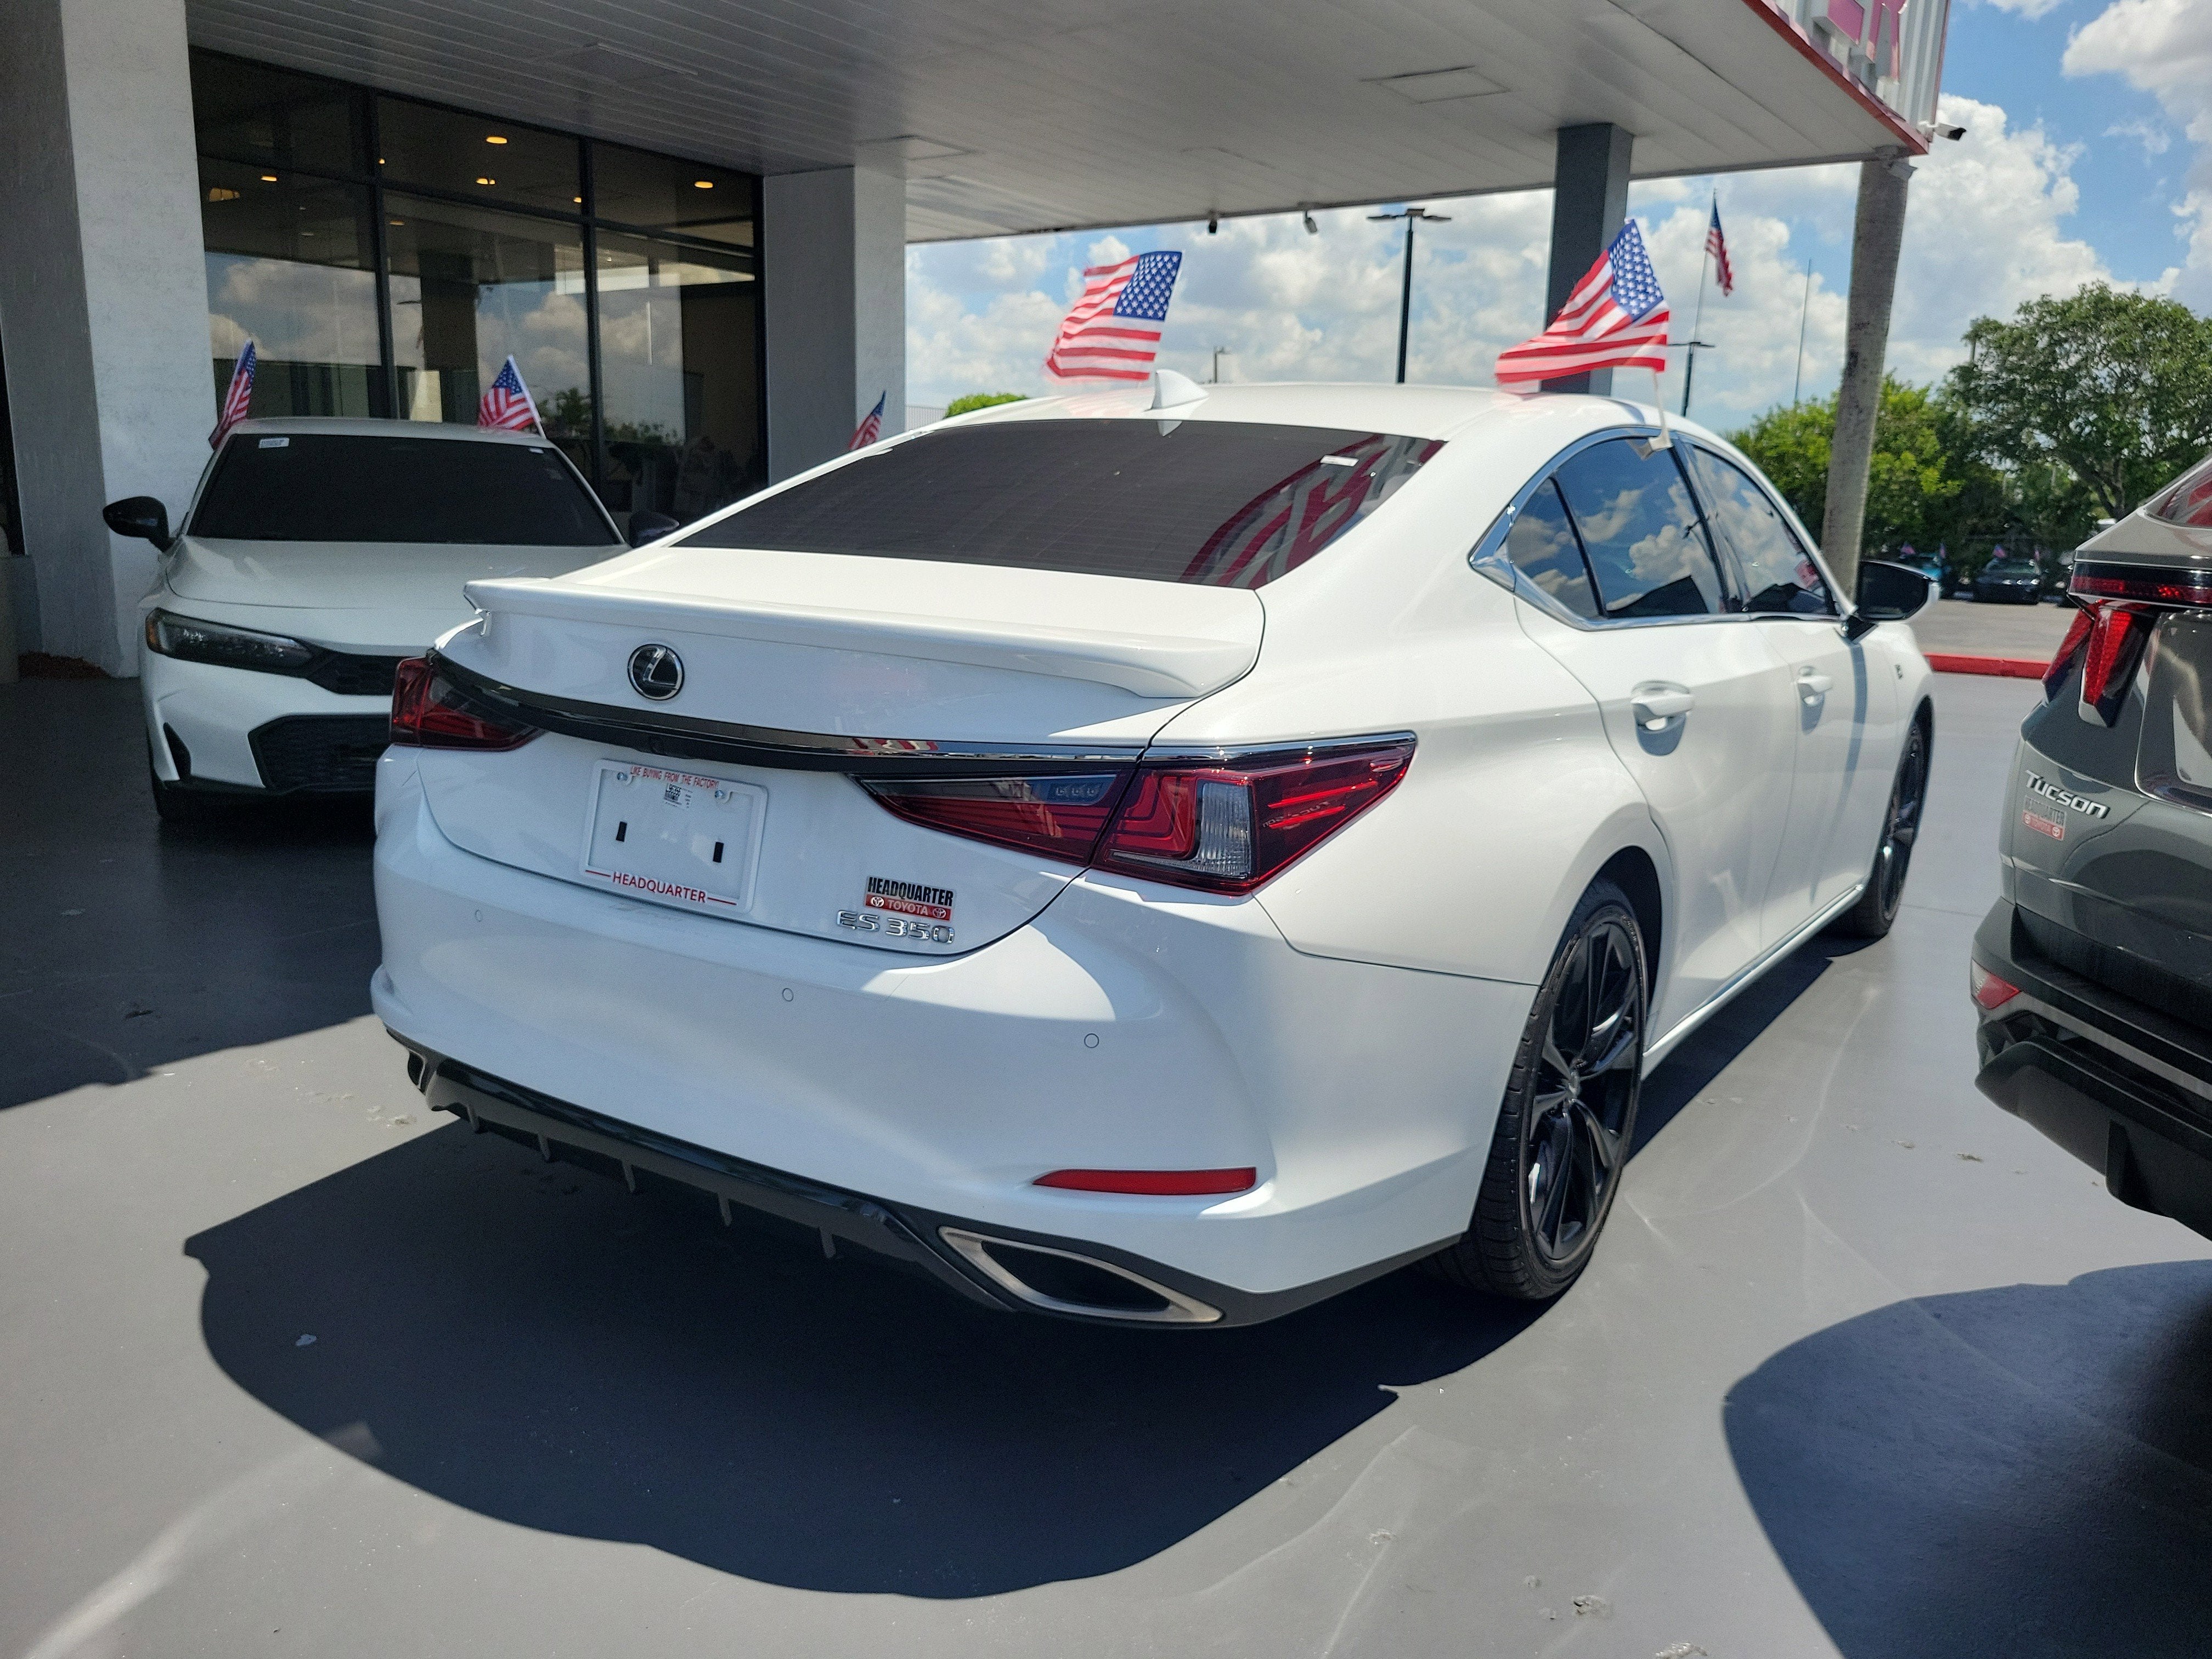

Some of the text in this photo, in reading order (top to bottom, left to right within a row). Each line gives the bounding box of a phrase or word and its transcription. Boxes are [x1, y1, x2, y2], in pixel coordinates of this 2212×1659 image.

[643, 768, 662, 780] BUYING
[665, 772, 680, 783] FROM
[682, 775, 692, 785] THE
[613, 871, 706, 902] HEADQUARTER
[867, 877, 953, 906] HEADQUARTER
[888, 900, 929, 916] TOYOTA
[836, 910, 955, 944] ES 350
